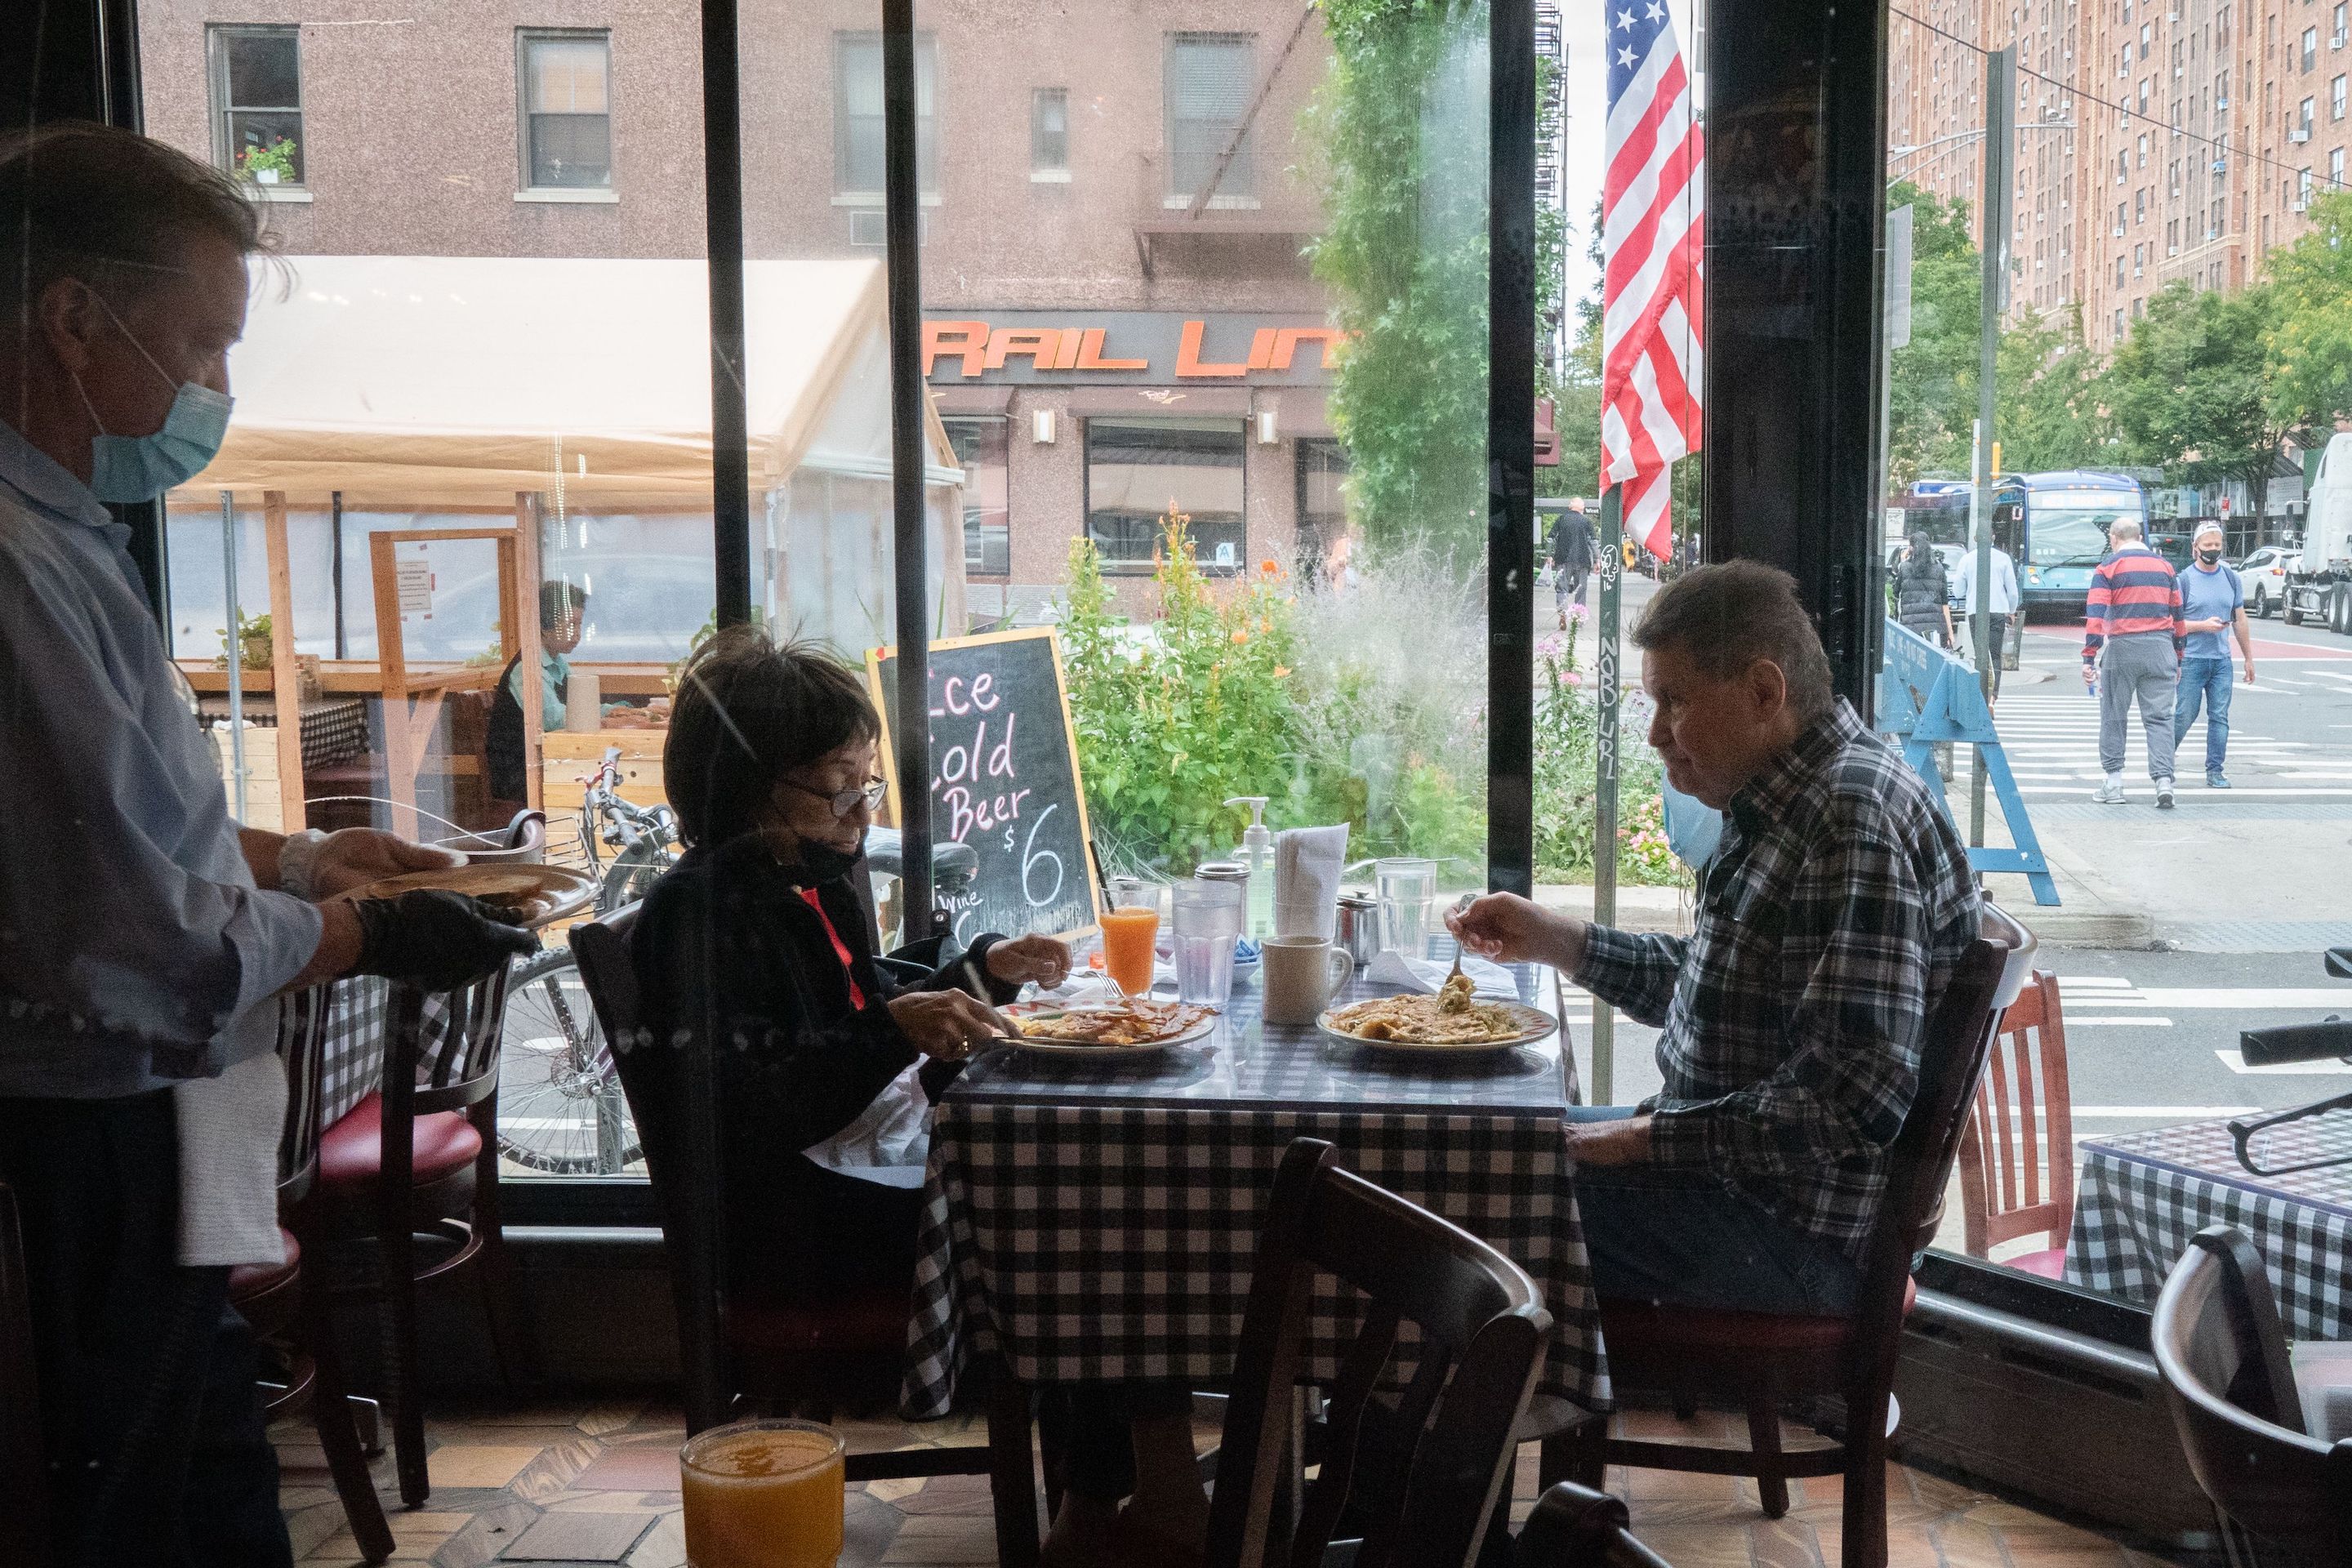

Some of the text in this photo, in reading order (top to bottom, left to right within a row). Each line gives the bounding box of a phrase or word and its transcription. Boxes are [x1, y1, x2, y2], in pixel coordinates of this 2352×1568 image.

[922, 320, 1149, 376] RAIL
[929, 668, 1001, 716] ce
[929, 712, 1015, 791] old
[942, 786, 1031, 844] Beer
